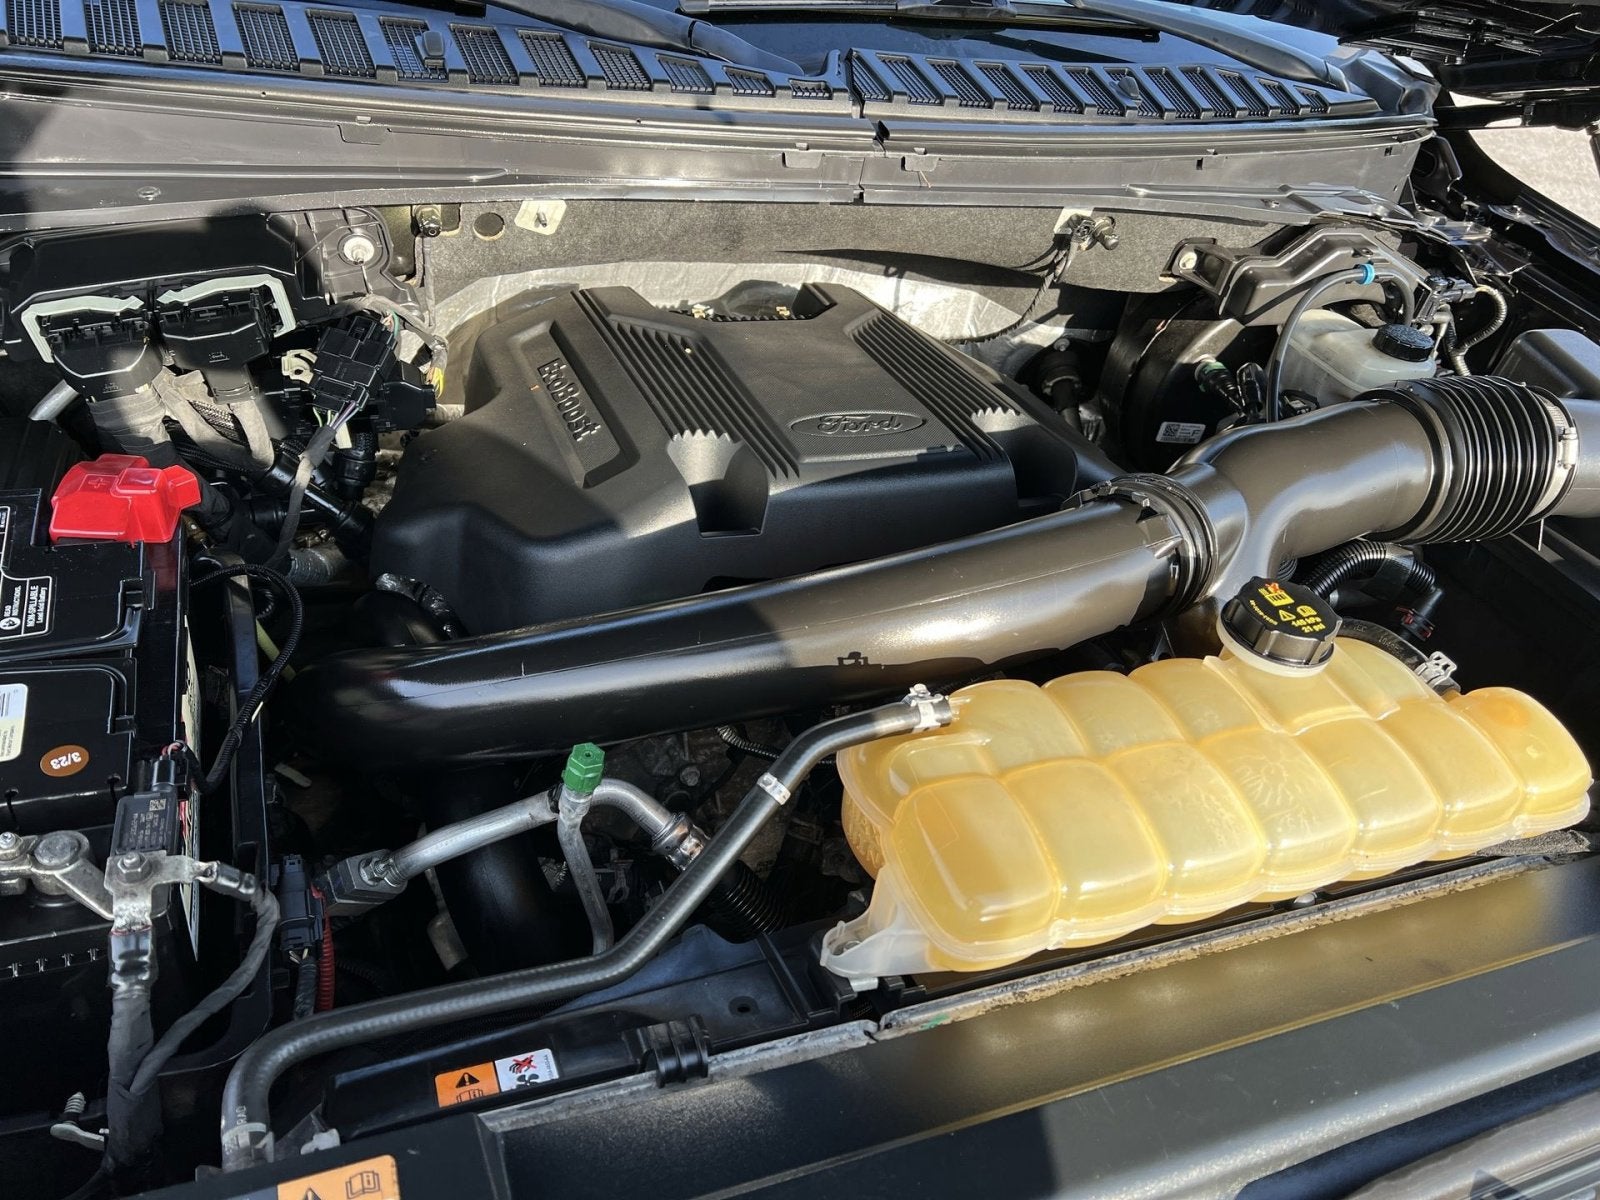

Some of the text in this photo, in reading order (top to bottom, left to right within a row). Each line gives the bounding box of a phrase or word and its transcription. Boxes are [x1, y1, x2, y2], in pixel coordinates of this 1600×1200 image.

[537, 357, 601, 442] EcoBoost
[817, 413, 903, 435] Ford
[50, 751, 82, 770] 3/23
